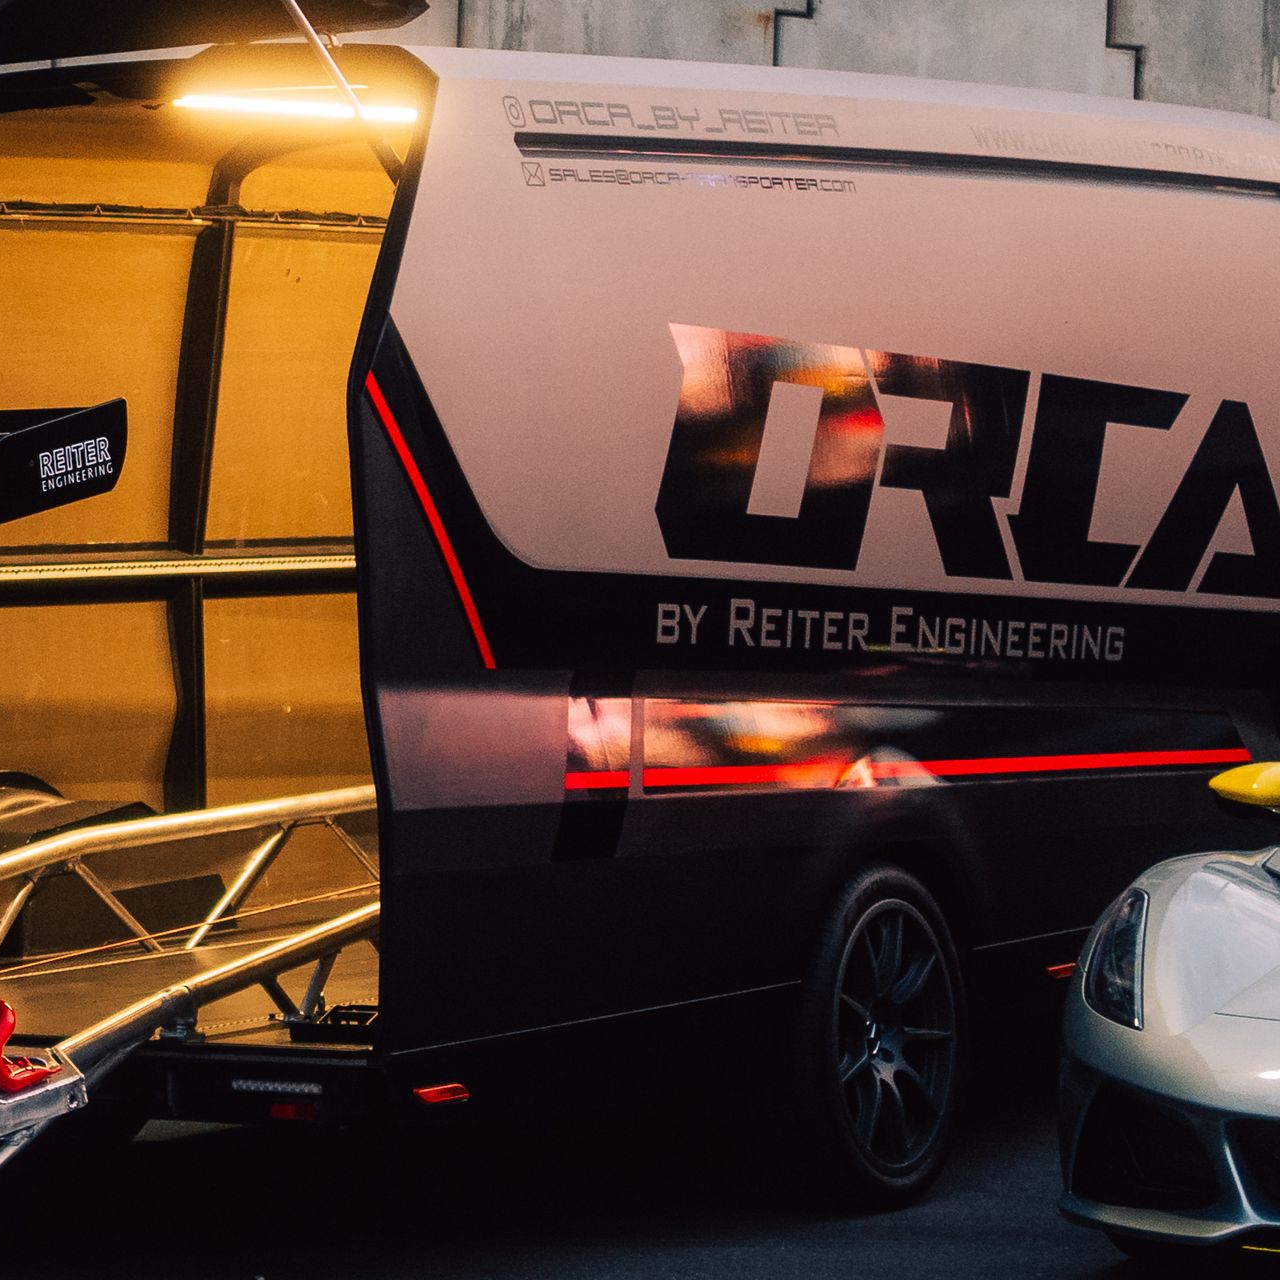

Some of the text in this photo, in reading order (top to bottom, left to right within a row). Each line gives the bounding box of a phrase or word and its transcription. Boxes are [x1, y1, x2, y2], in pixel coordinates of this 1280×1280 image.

[549, 168, 856, 193] SALES@ORCA-TRASPORTER.COM
[39, 437, 111, 478] REITER
[41, 462, 114, 492] ENGINEERING
